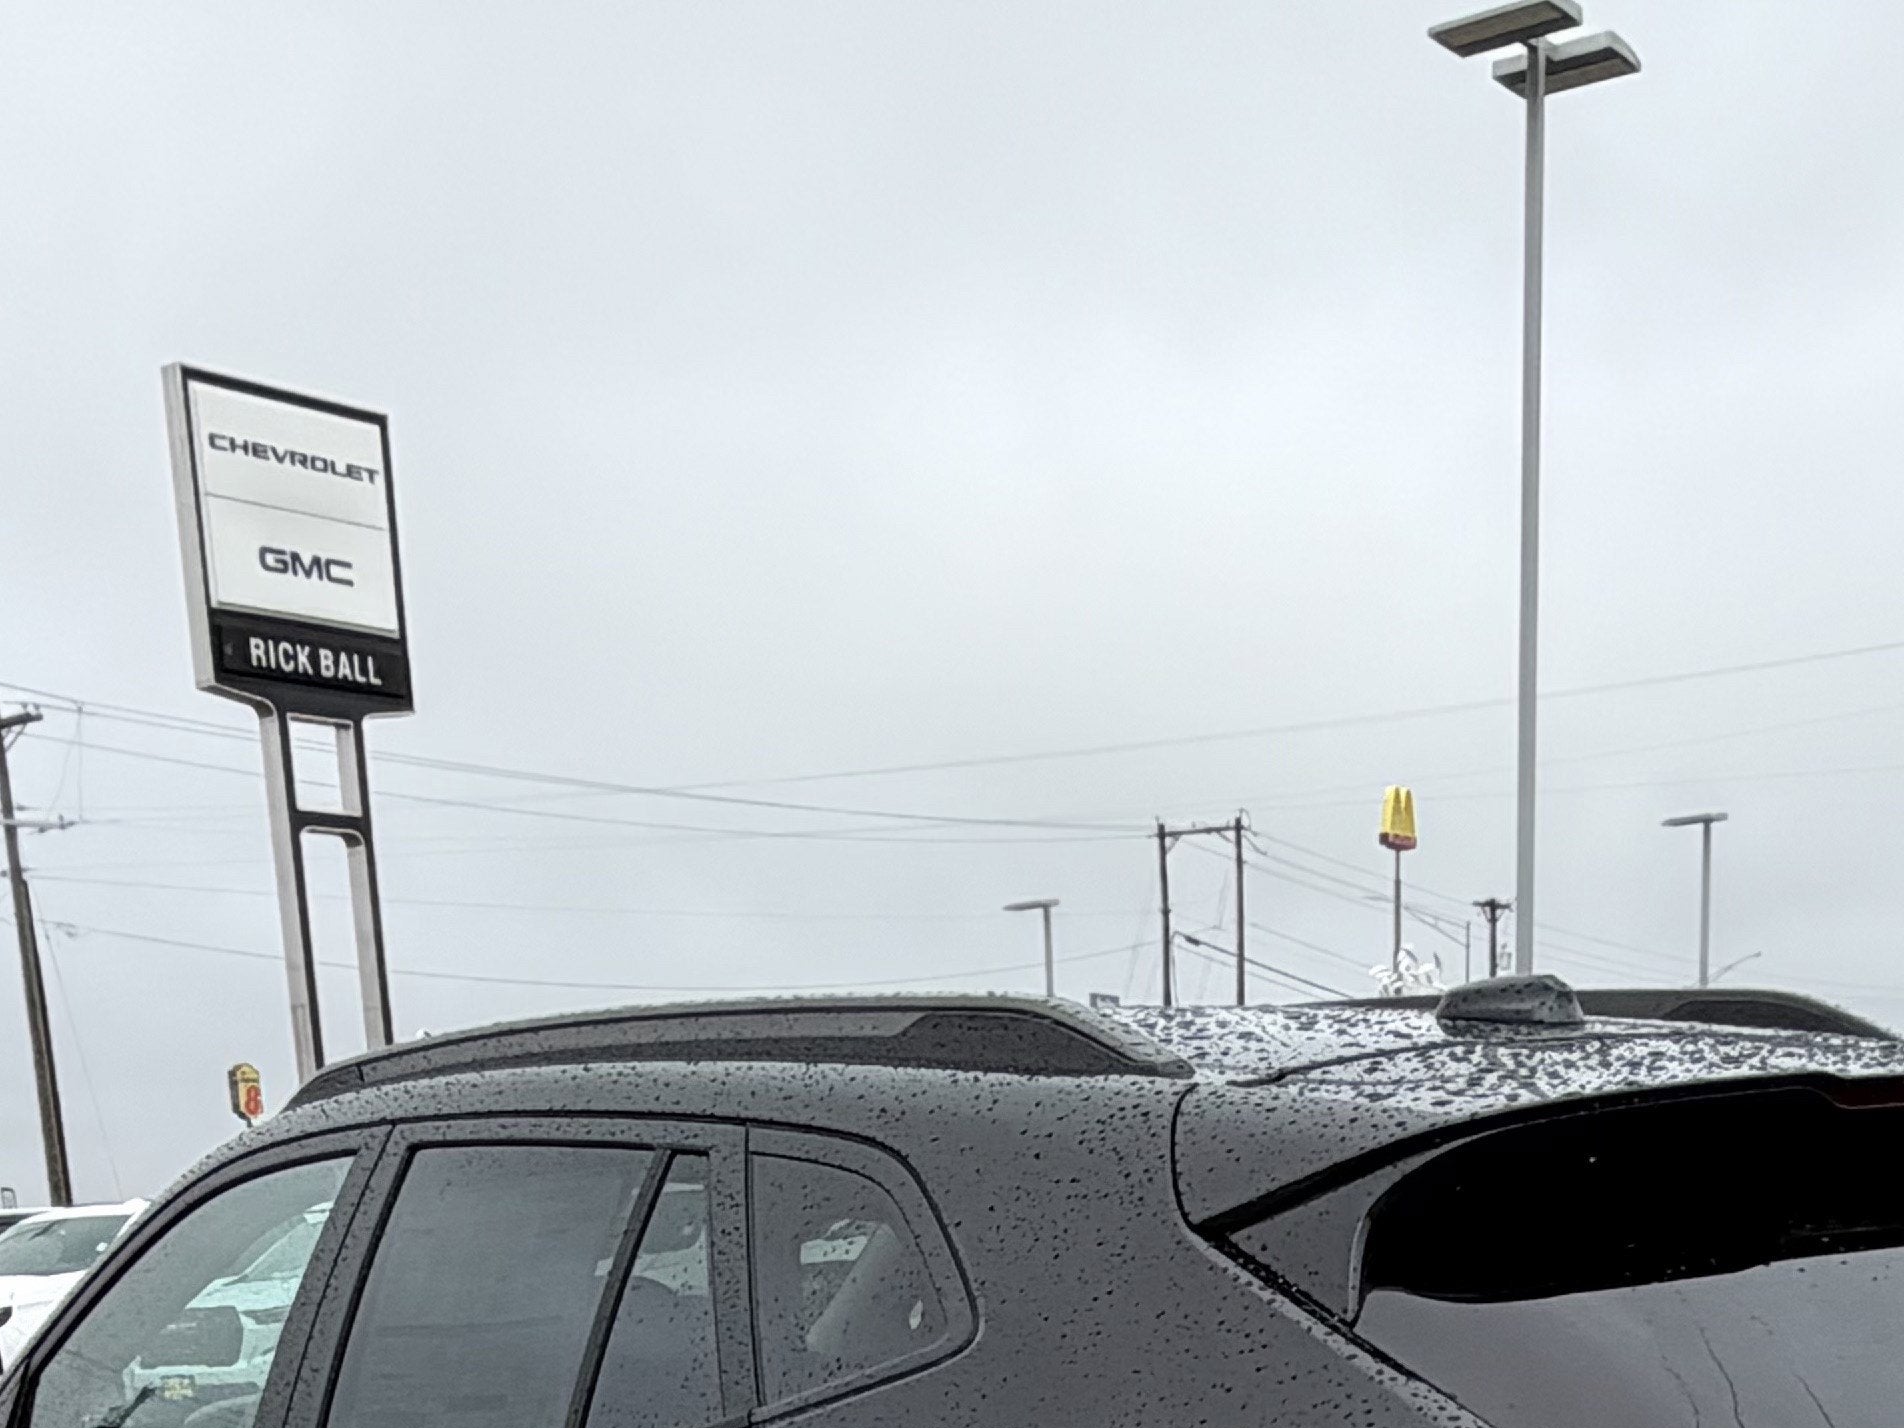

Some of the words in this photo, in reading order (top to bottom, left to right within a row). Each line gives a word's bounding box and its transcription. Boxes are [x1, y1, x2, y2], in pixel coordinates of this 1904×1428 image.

[207, 432, 380, 486] CHEVROLET
[258, 546, 355, 588] GMC
[248, 636, 314, 676] RICK
[318, 647, 383, 687] BALL
